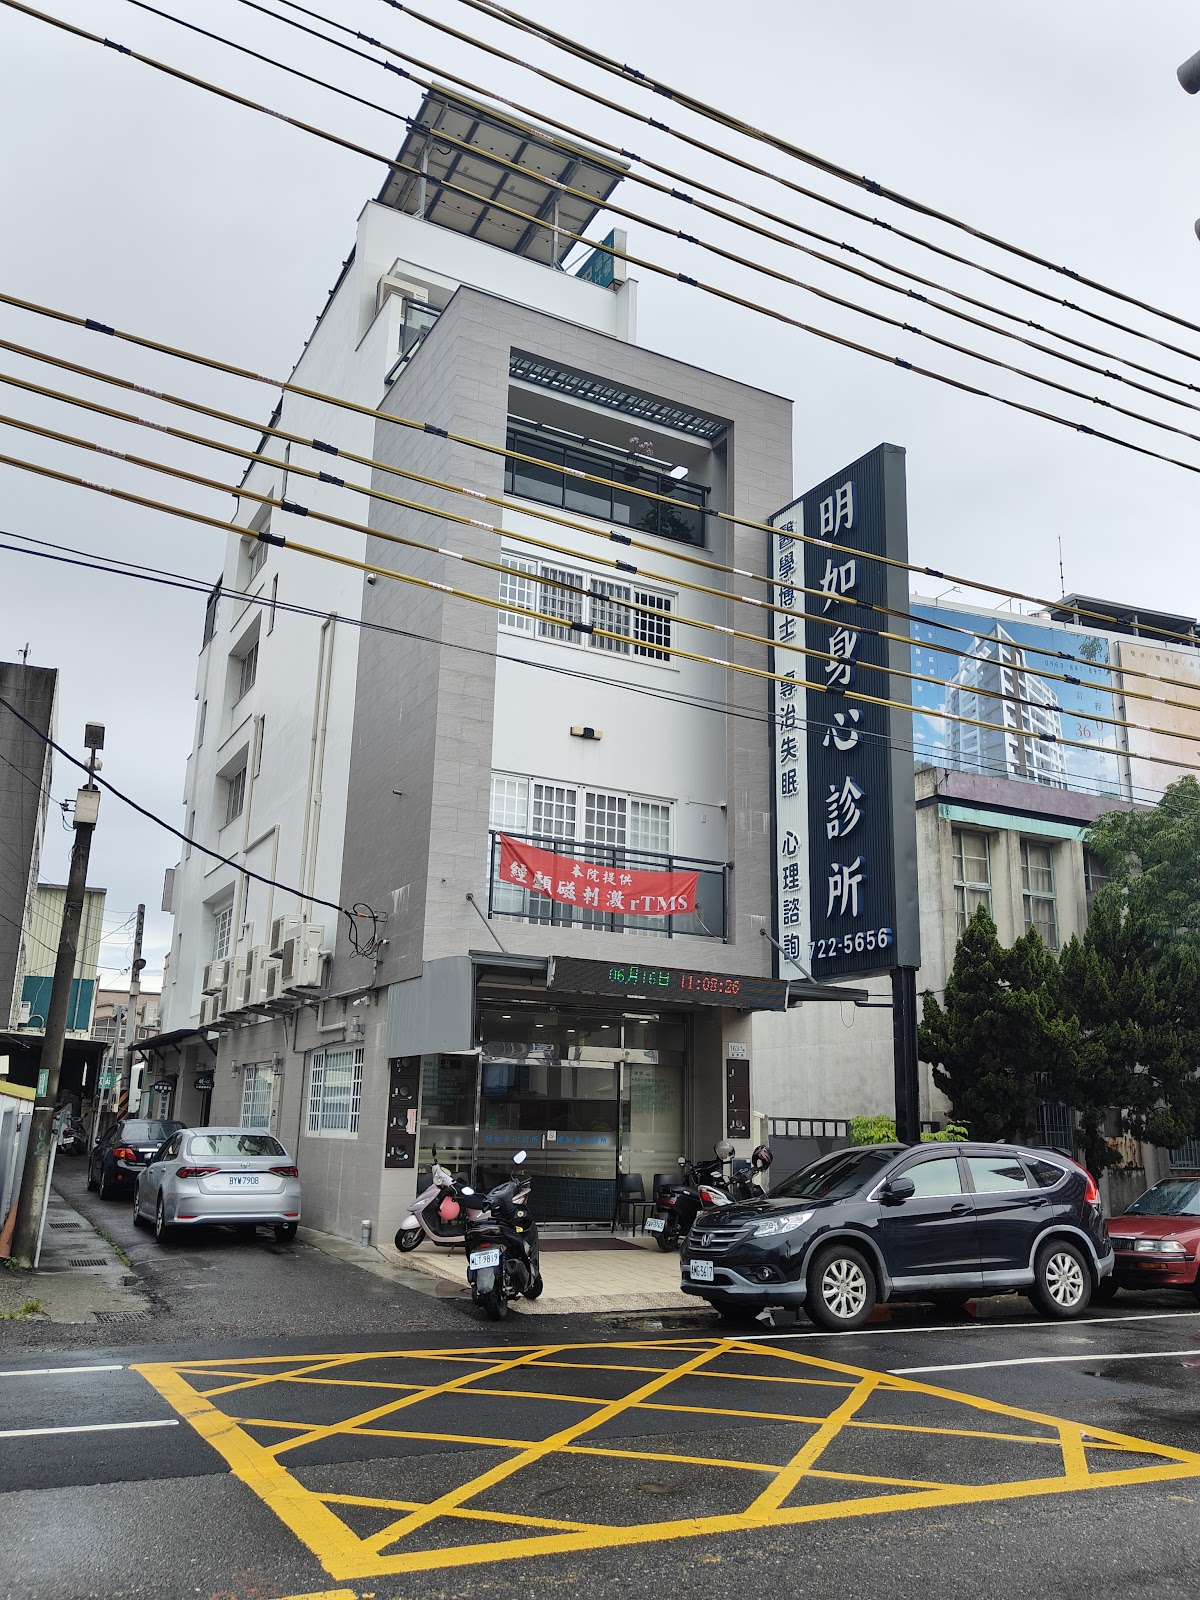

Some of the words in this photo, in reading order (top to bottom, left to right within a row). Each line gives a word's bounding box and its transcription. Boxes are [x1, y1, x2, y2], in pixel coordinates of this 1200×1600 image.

[778, 521, 797, 642] 醫學博士
[779, 670, 799, 797] 專治失眠
[819, 481, 865, 918] 明如身心診所
[571, 864, 633, 887] 本院提供
[782, 831, 802, 961] 心理諮詢
[608, 966, 670, 987] 06月16日
[808, 927, 891, 960] 722-5656
